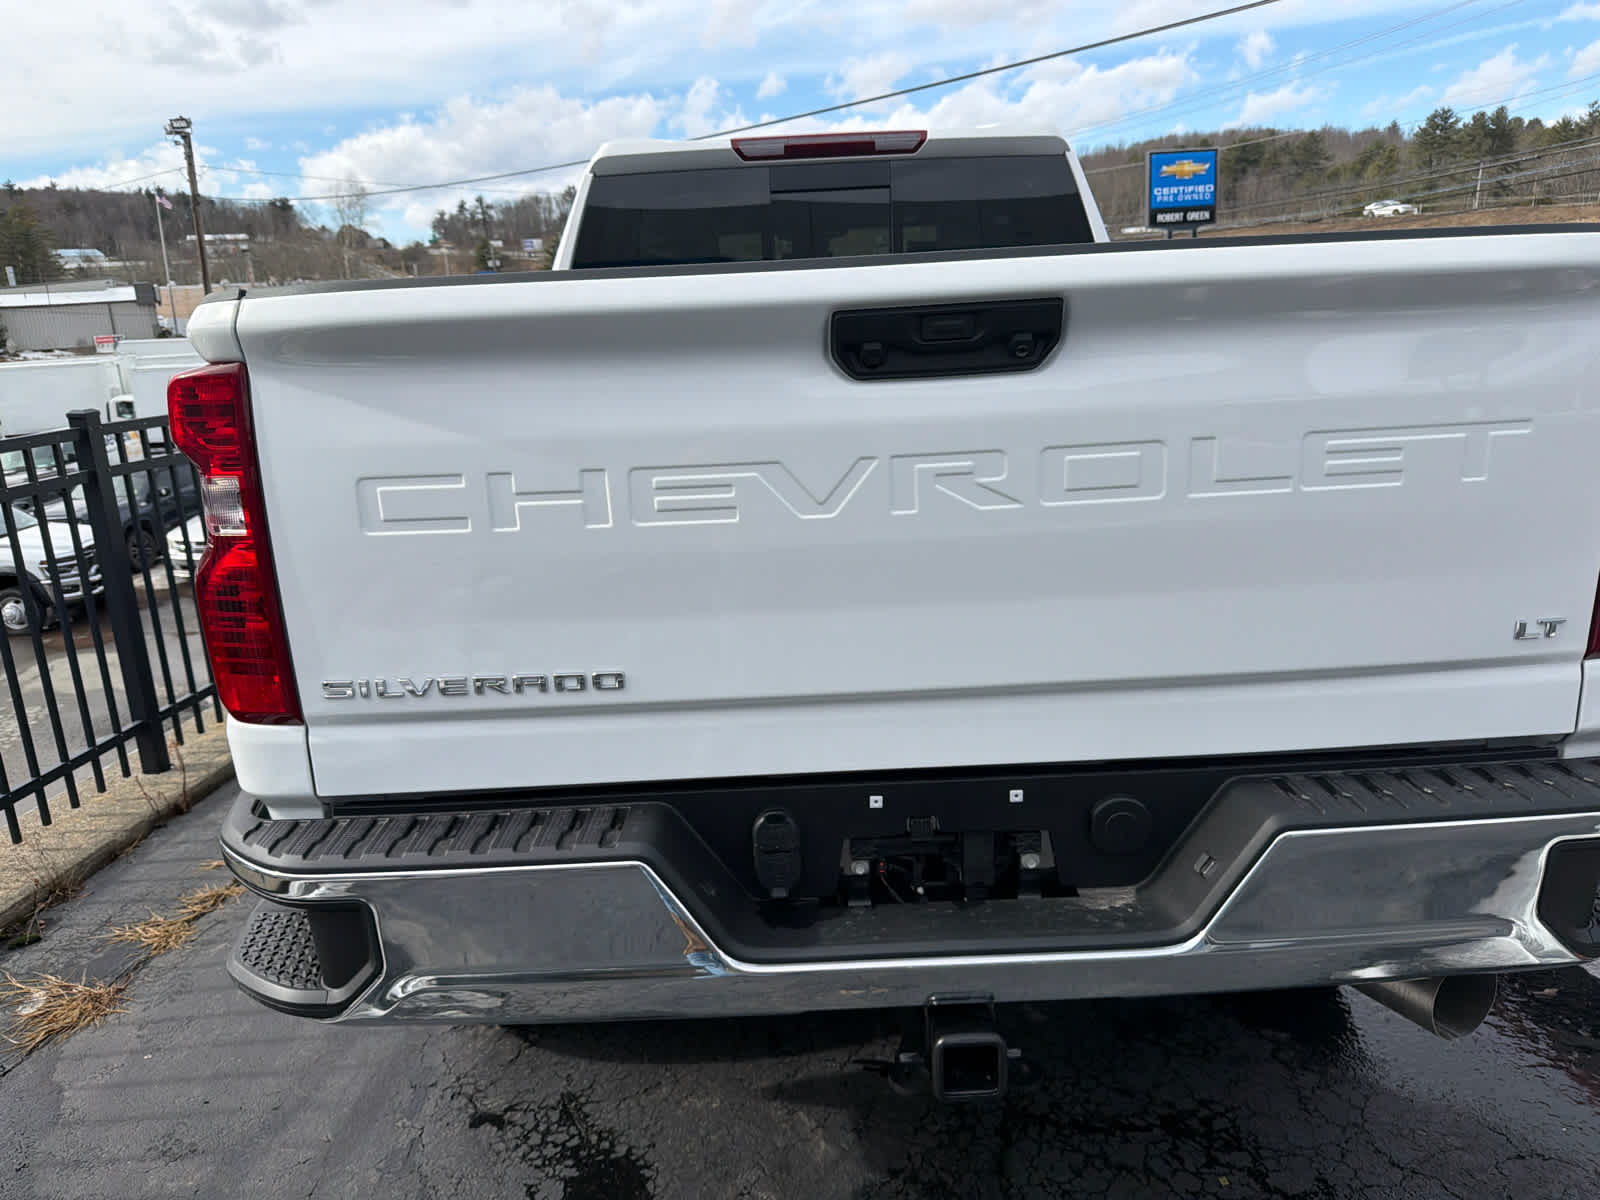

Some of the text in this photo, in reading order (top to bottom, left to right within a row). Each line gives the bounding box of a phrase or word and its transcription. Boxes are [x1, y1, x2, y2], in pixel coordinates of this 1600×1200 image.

[1153, 184, 1214, 195] CERTIFIED
[1156, 210, 1210, 223] ROBERT GREEN
[357, 418, 1533, 536] CHEVROLET
[1513, 616, 1567, 640] LT
[321, 671, 626, 699] SILVERADO
